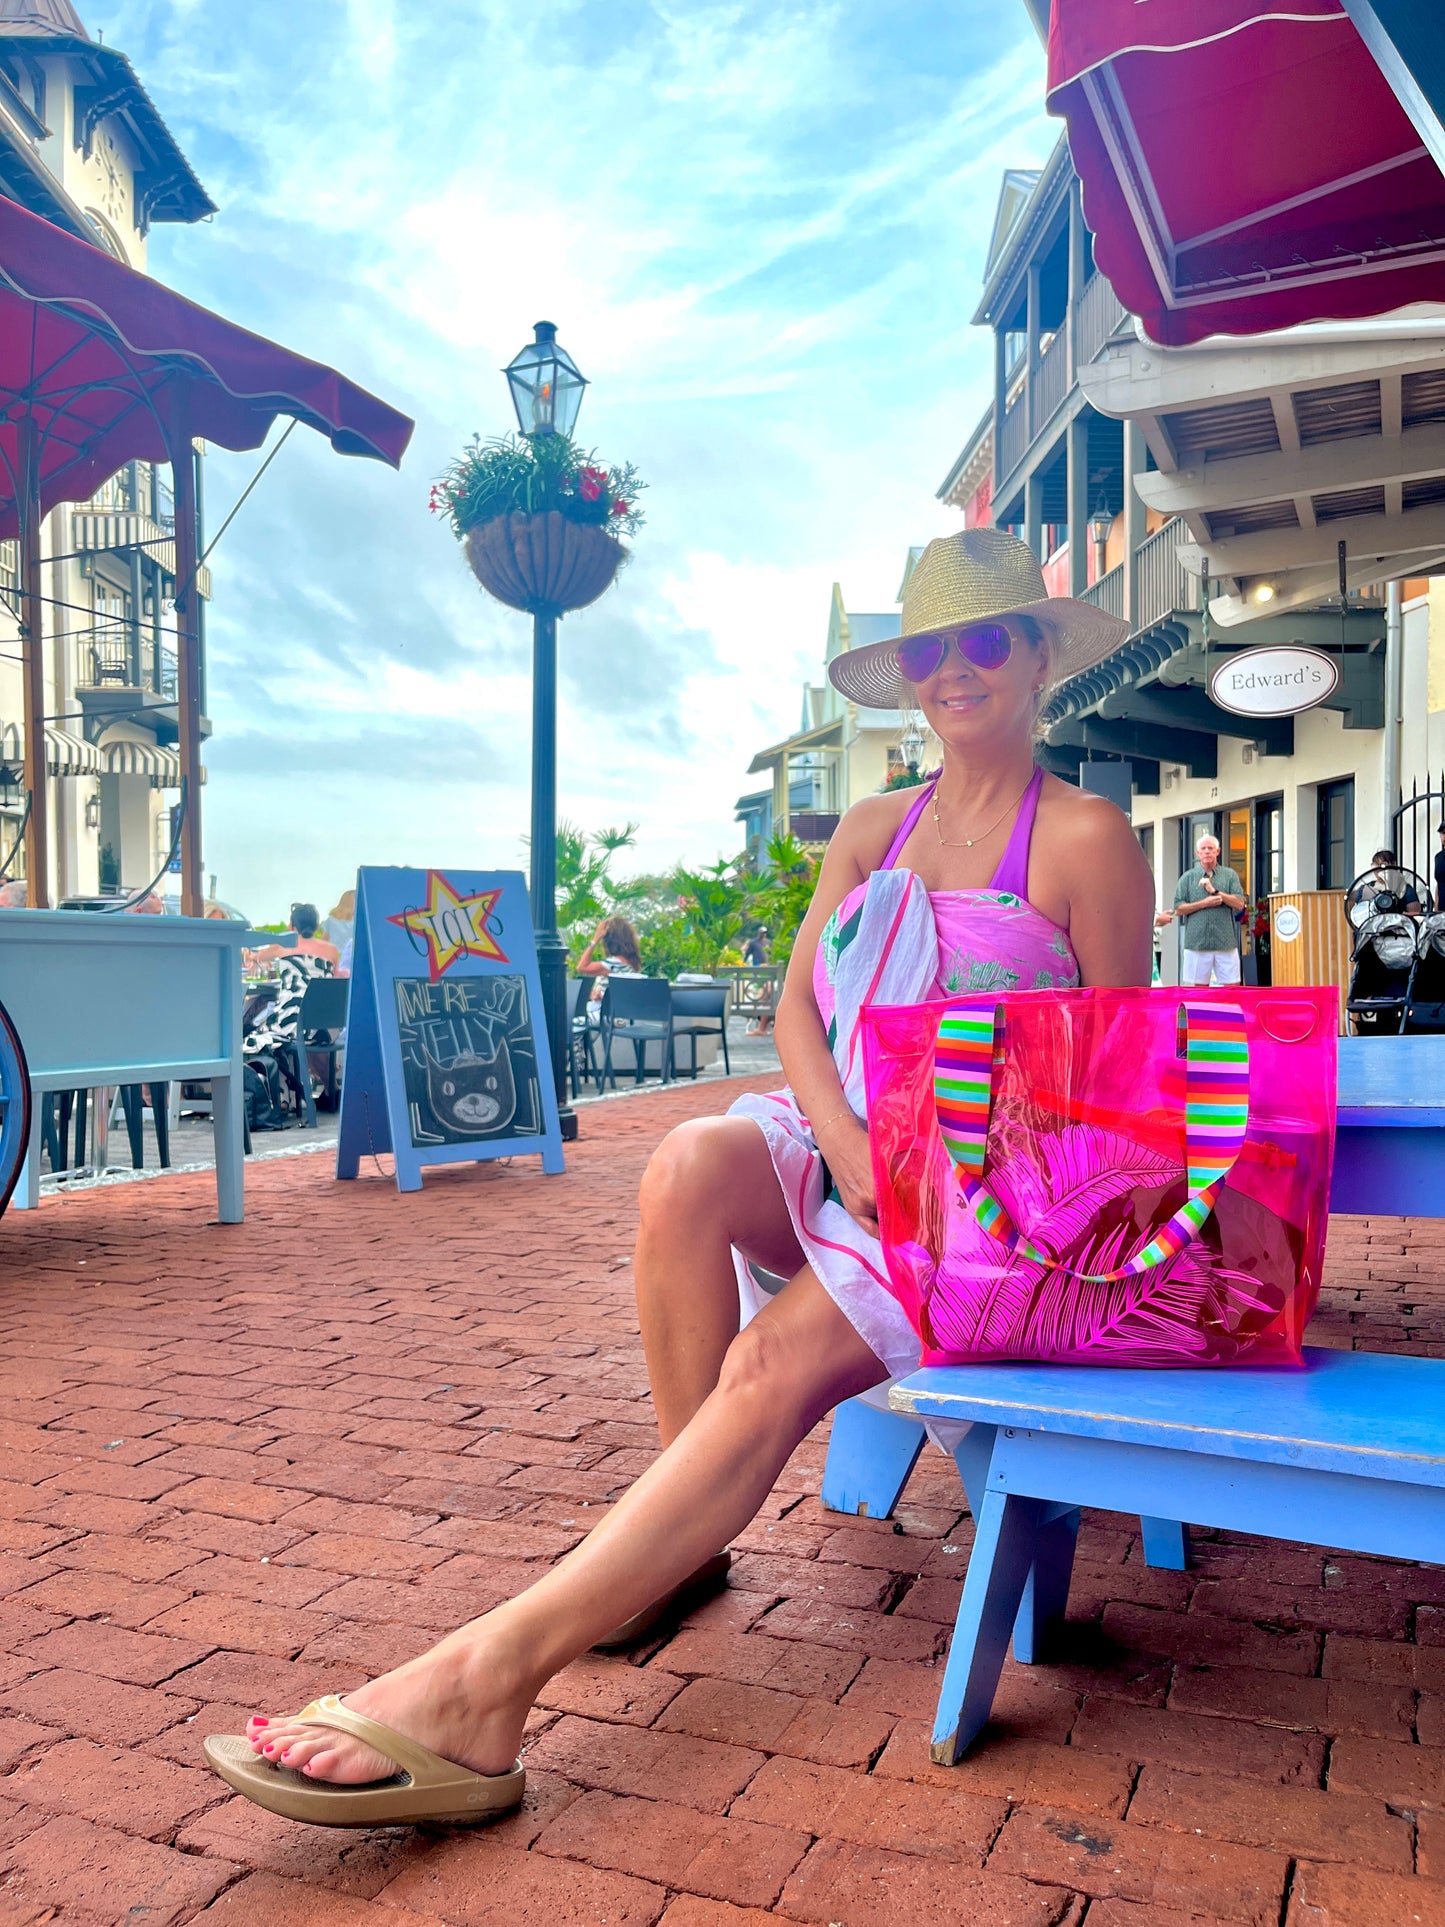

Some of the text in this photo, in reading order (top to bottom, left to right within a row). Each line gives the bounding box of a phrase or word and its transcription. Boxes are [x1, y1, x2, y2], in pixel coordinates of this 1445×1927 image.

[1231, 665, 1322, 691] Edward's
[398, 979, 516, 1019] WE'RE SO
